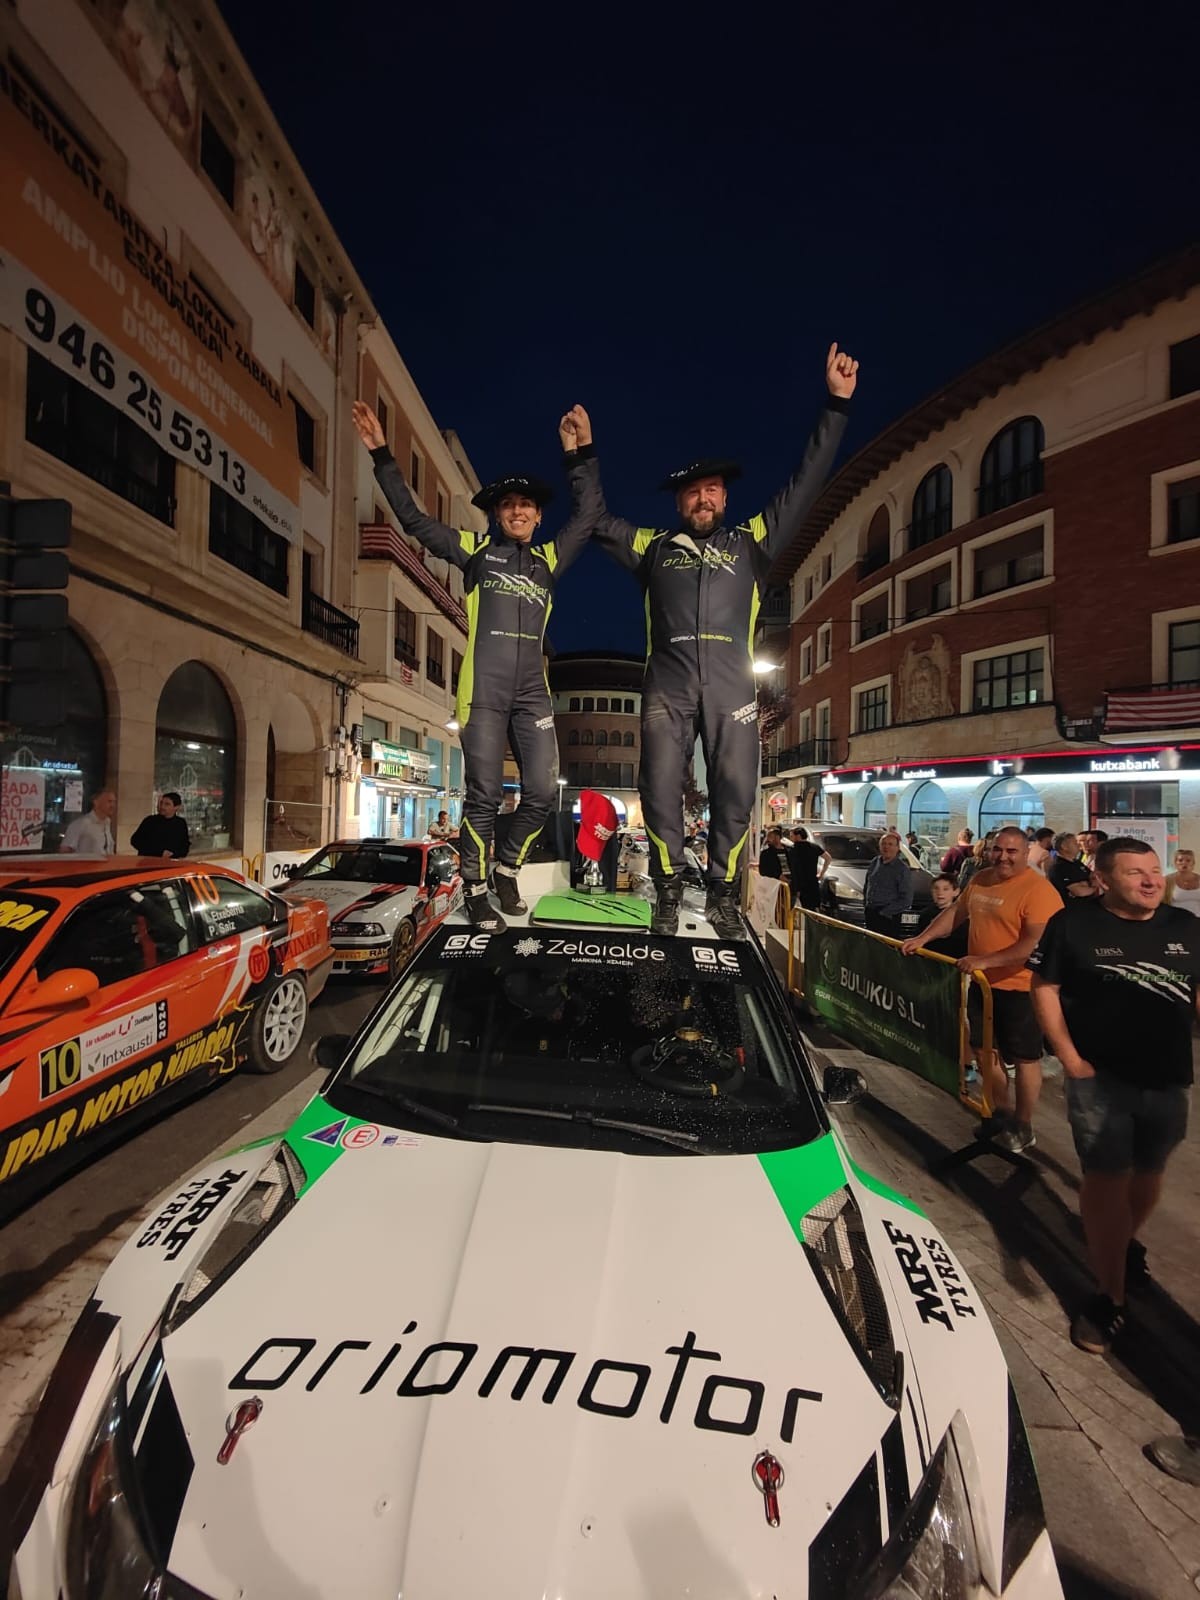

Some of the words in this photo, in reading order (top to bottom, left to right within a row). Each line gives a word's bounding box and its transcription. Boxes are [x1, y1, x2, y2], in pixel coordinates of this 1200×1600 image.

[21, 176, 127, 297] AMPLIO
[132, 281, 192, 361] LOCAL
[195, 346, 276, 449] COMERCIAL
[122, 236, 226, 363] ESKURAGAI
[24, 286, 115, 391] 946
[127, 370, 162, 432] 25
[168, 412, 213, 467] 53
[218, 449, 246, 496] 13
[121, 311, 228, 428] DISPONIBLE
[233, 340, 283, 408] ZABALA
[1090, 757, 1160, 772] kutxabank
[186, 870, 220, 905] 10
[41, 1041, 81, 1094] 10
[102, 1031, 153, 1068] Intxausti
[175, 1030, 204, 1051] TALLERES
[0, 1106, 79, 1182] IPAR
[76, 1059, 163, 1136] MOTOR
[162, 1022, 235, 1086] NAVARRA
[136, 1178, 212, 1249] TYRES
[161, 1168, 248, 1261] MRF
[881, 1218, 955, 1332] MRF
[920, 1236, 977, 1318] TYRES
[228, 1320, 823, 1443] oriomotor
